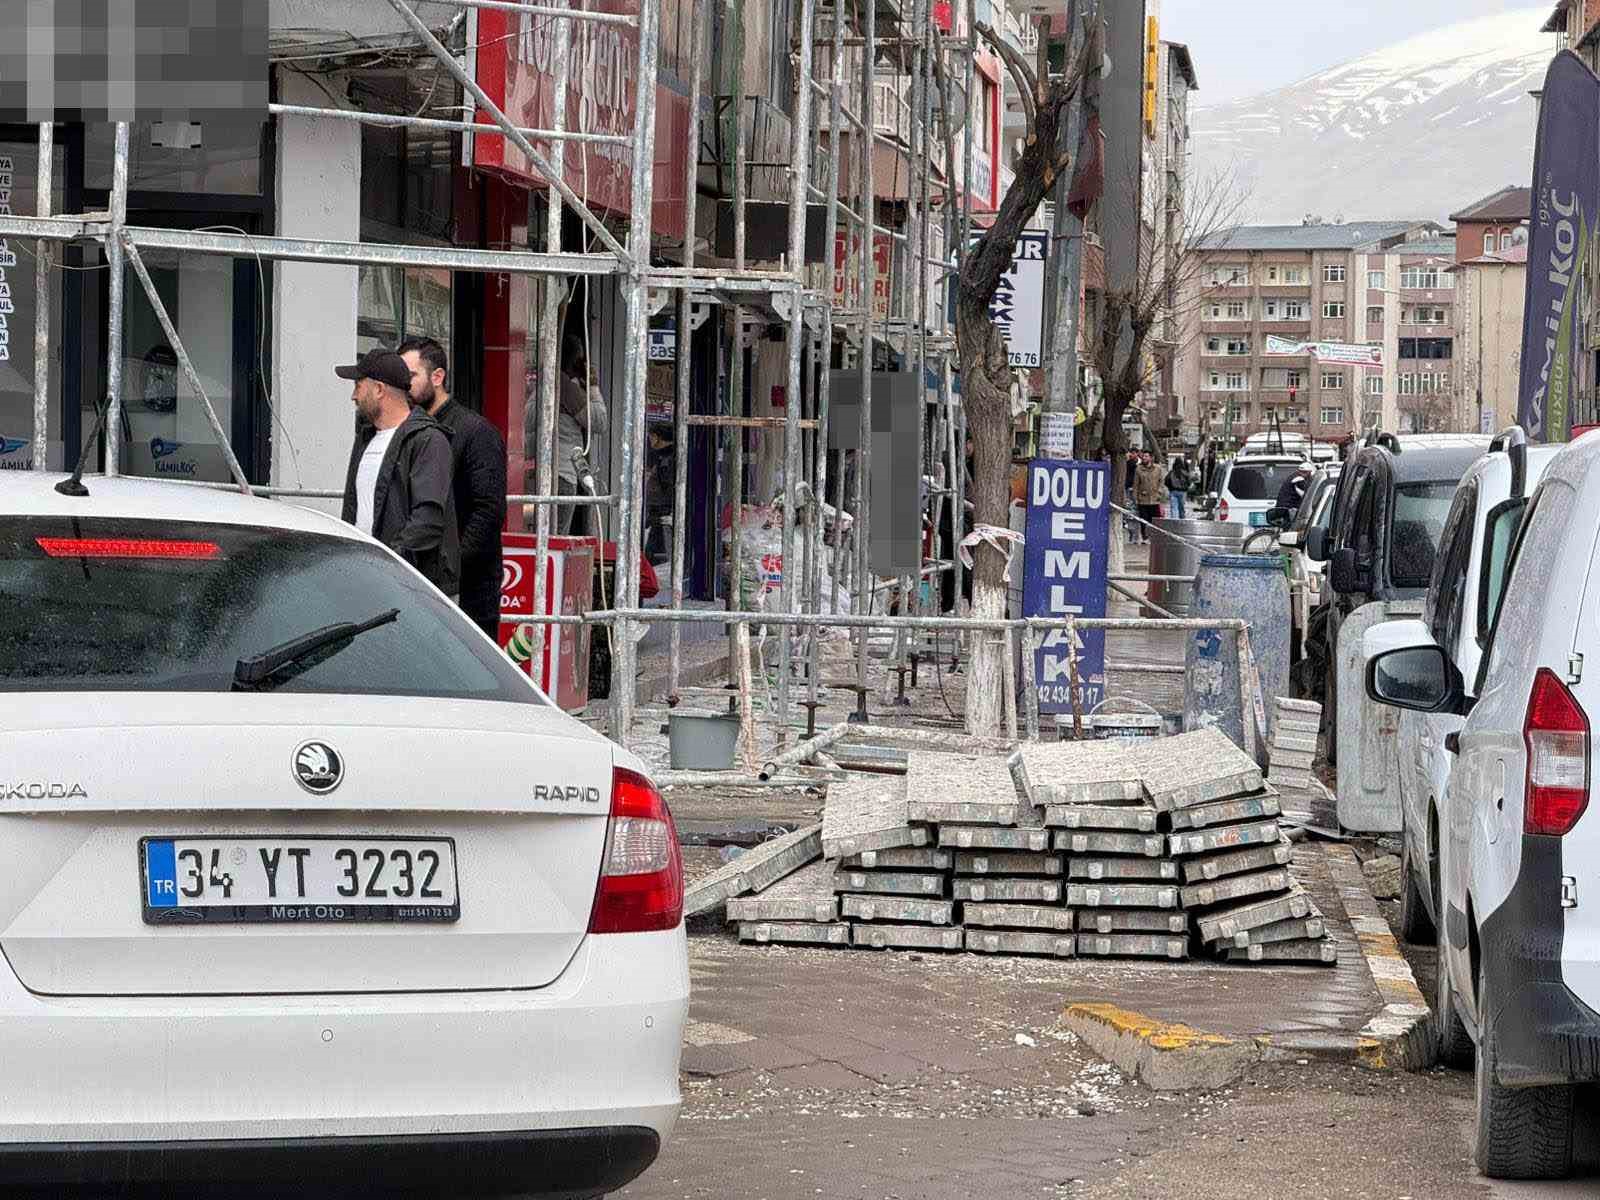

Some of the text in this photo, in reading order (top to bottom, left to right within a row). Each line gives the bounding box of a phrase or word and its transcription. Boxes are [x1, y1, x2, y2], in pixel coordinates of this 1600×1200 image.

[1033, 467, 1104, 509] DOLU
[1043, 511, 1090, 684] EMLAK
[534, 785, 600, 802] RAPID
[154, 848, 442, 898] TR 34 YT 3232
[272, 906, 345, 919] Mert Oto
